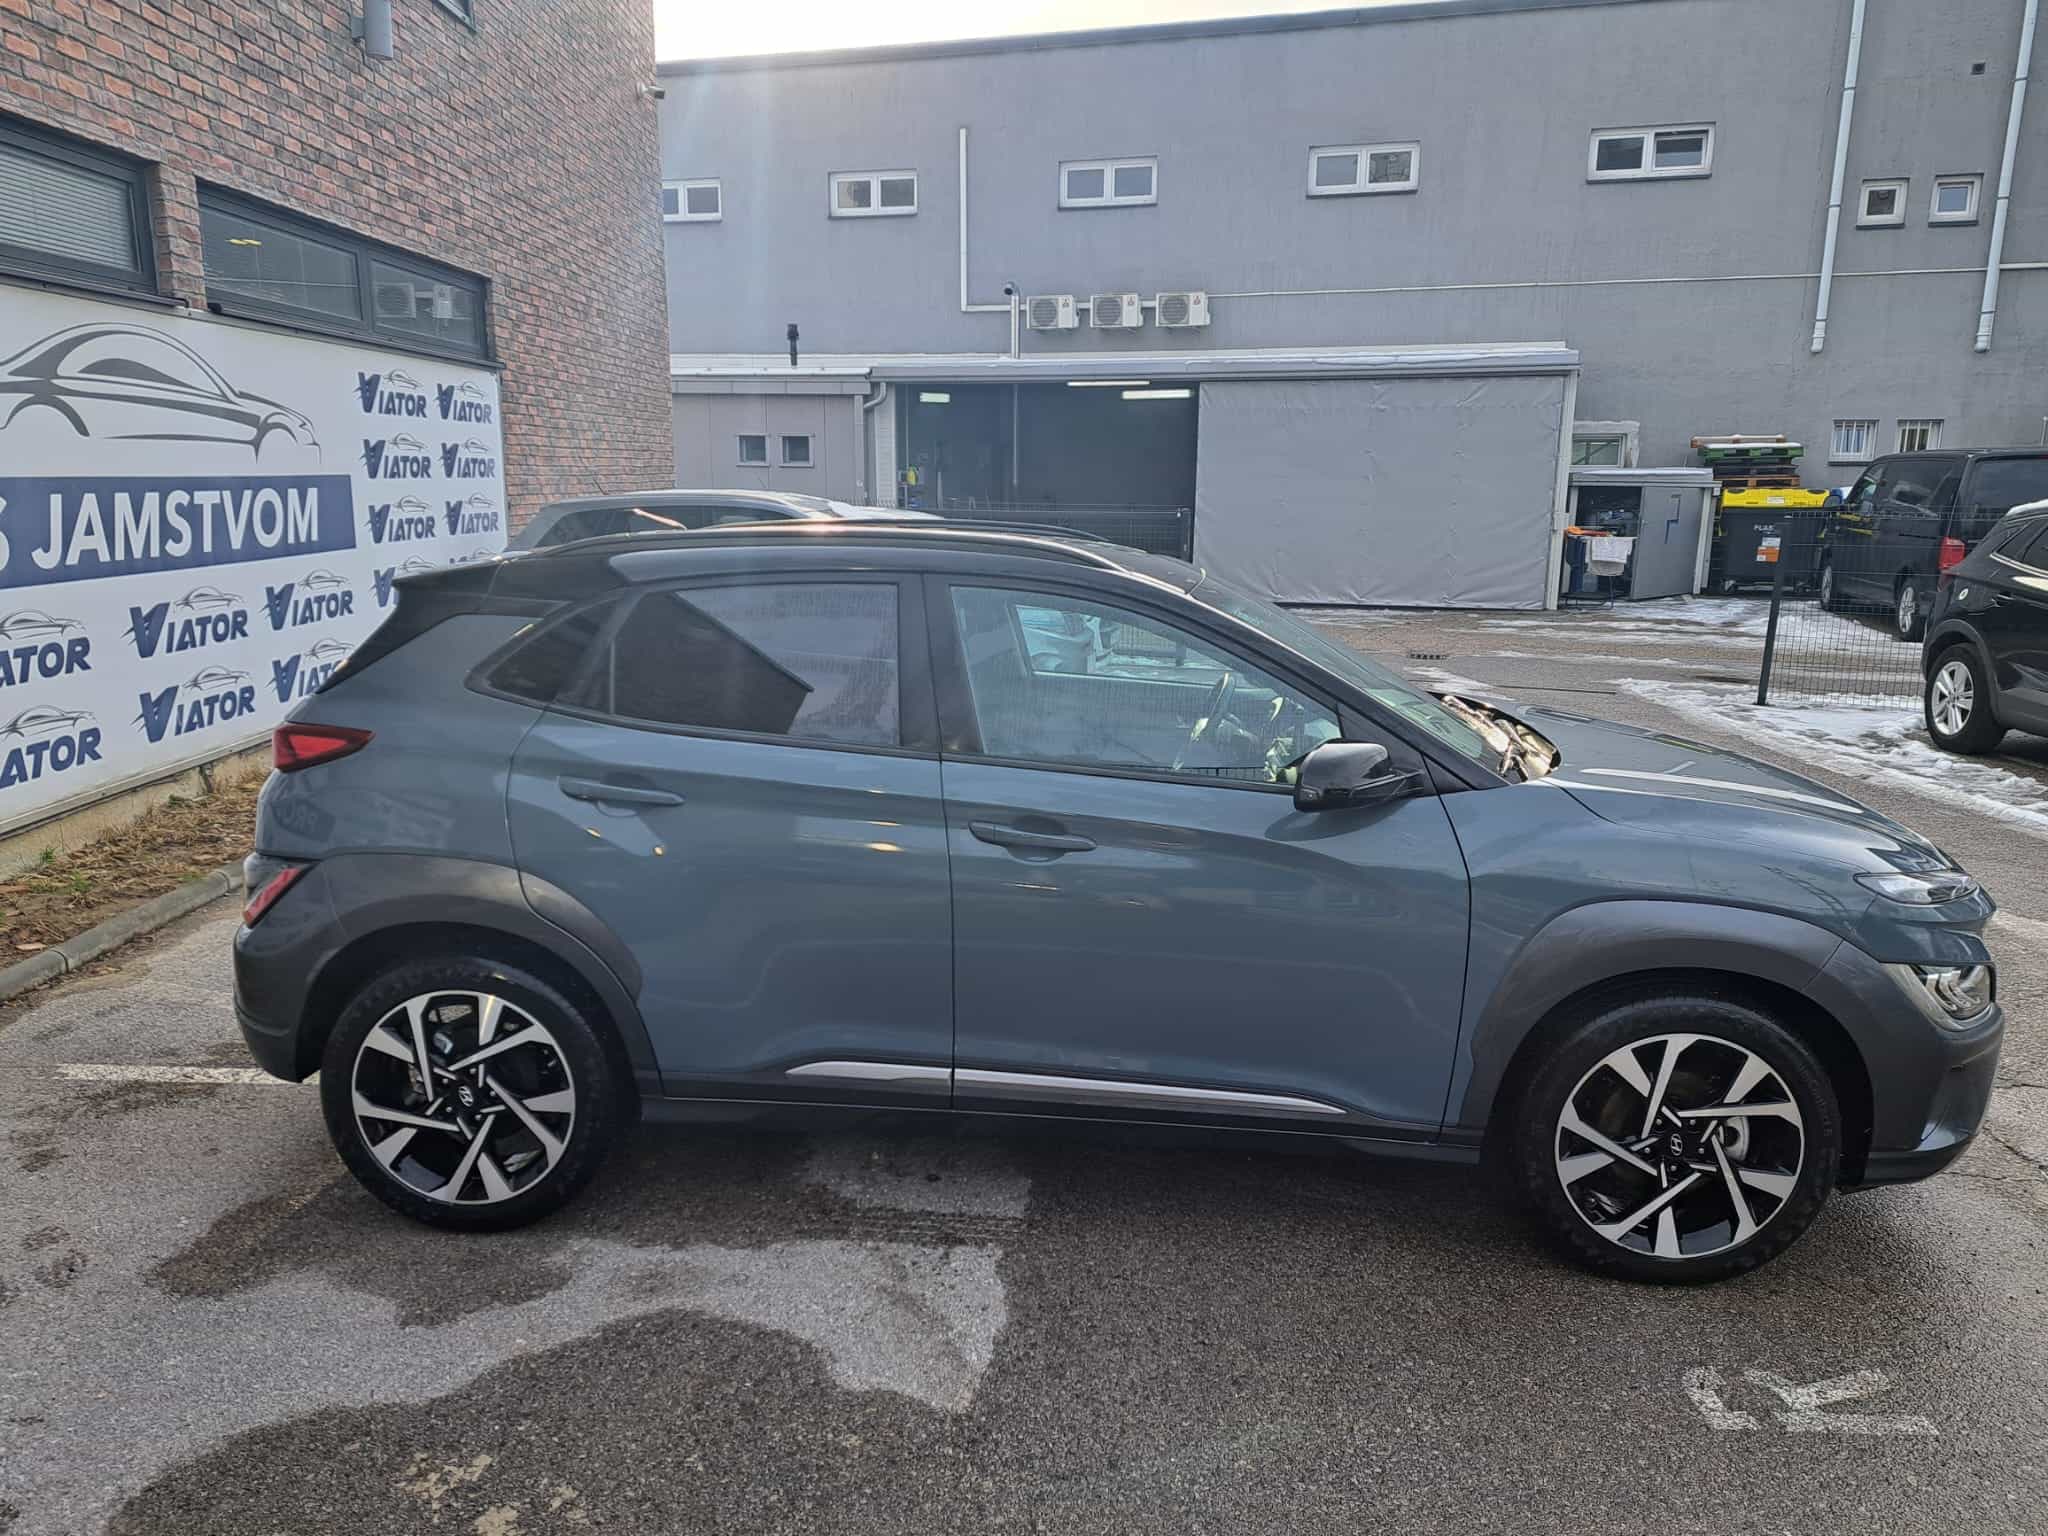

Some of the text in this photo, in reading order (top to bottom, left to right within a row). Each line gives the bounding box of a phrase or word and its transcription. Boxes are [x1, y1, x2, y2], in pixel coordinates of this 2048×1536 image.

[357, 372, 428, 419] VIATOR
[437, 383, 493, 424] VIATOR
[363, 439, 432, 480] VIATOR
[441, 442, 496, 478] VIATOR
[31, 487, 319, 570] JAMSTVOM
[368, 503, 437, 544] VIATOR
[445, 500, 500, 536] VIATOR
[265, 582, 355, 631] VIATOR
[128, 602, 249, 659] VIATOR
[272, 653, 342, 703] VIAT
[139, 685, 257, 744] VIATOR
